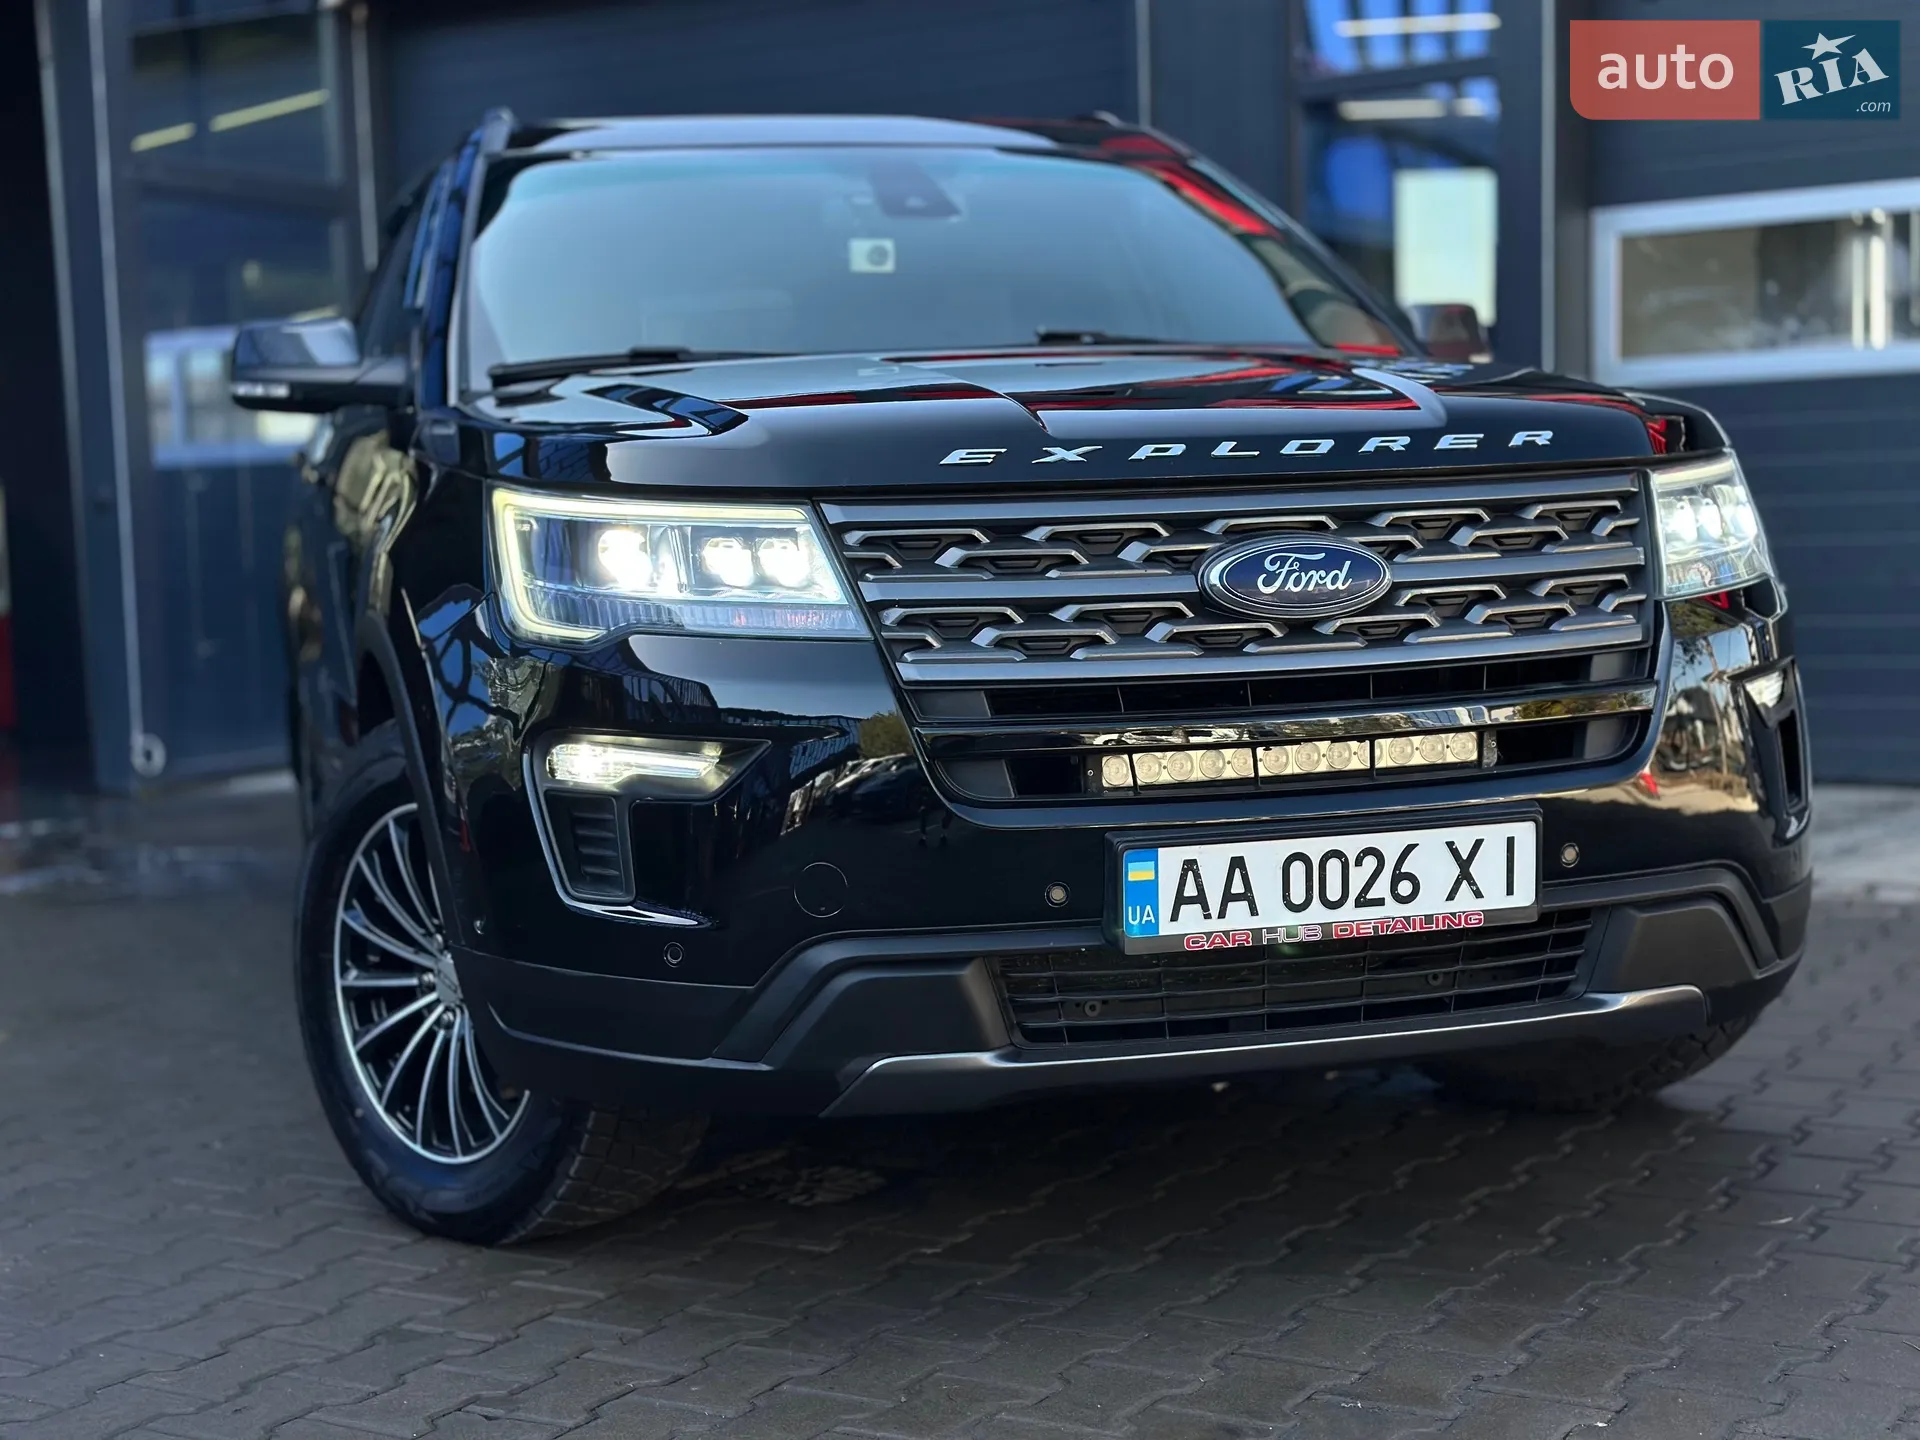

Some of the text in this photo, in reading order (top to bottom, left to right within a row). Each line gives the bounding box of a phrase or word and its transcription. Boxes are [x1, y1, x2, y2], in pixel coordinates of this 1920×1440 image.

[939, 430, 1553, 465] EXPLORER
[1257, 552, 1352, 595] Ford
[1169, 856, 1259, 922] AA
[1282, 844, 1421, 913] 0026
[1128, 905, 1155, 925] UA
[1183, 911, 1484, 951] CAR HUB DETAILING
